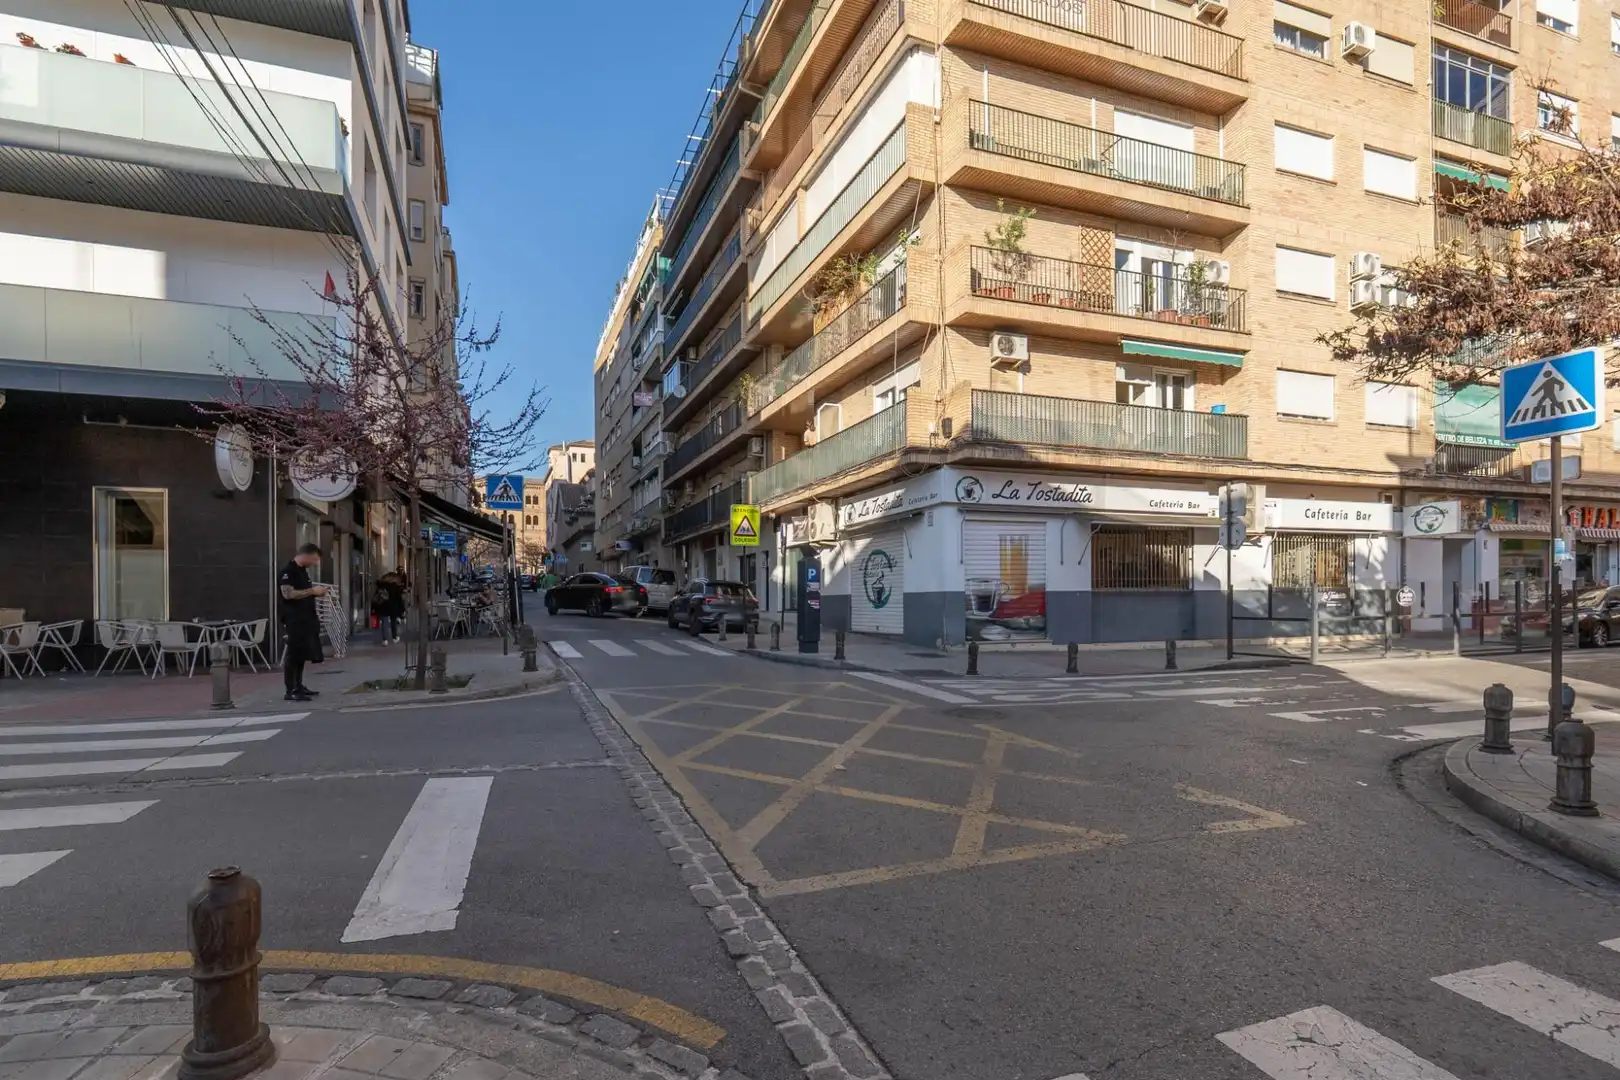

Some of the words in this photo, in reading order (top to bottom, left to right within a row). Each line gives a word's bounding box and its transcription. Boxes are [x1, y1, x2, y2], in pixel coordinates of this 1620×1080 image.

[992, 480, 1020, 500] La
[1027, 481, 1093, 503] Tostadita
[859, 501, 869, 517] La
[872, 494, 903, 514] Tostadita
[1188, 501, 1200, 509] Bar
[1356, 511, 1372, 521] Bar
[808, 568, 817, 580] P
